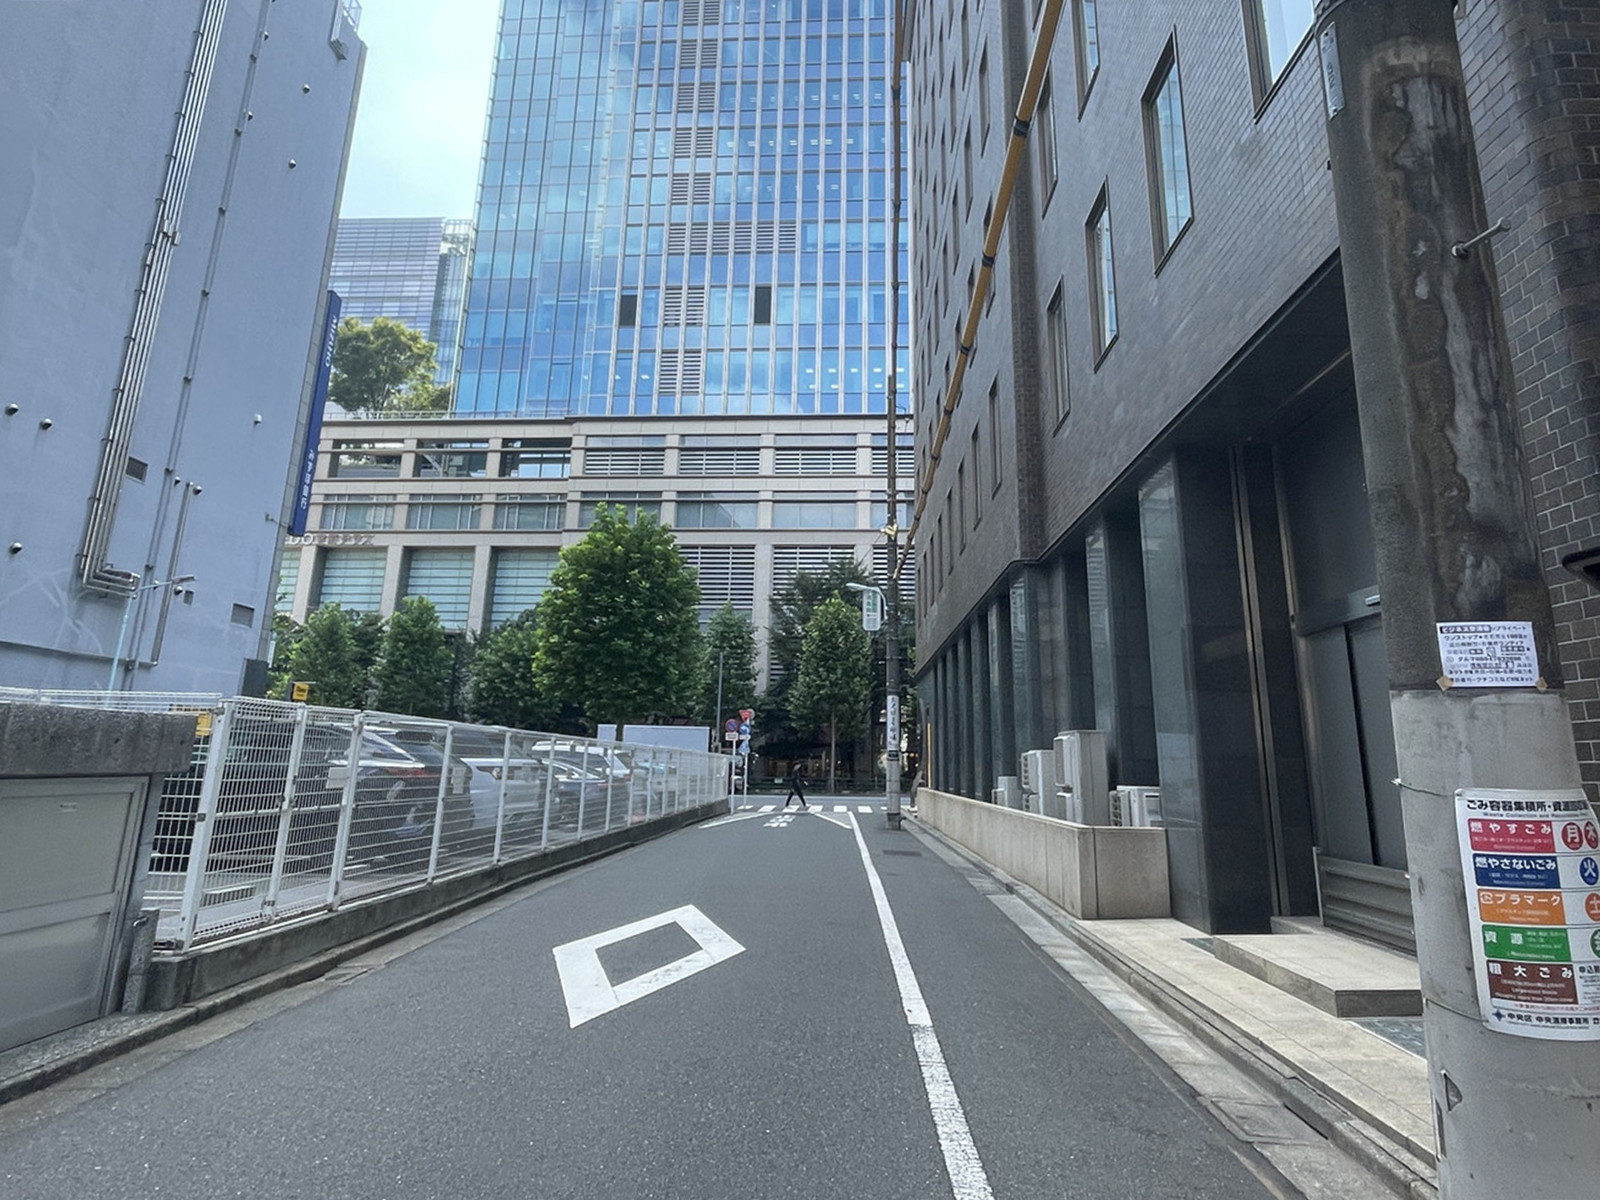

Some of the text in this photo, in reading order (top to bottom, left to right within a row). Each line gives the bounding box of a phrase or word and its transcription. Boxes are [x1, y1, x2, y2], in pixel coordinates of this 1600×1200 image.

[1566, 824, 1579, 843] 月
[1475, 856, 1596, 877] 燃やさないごみ 火
